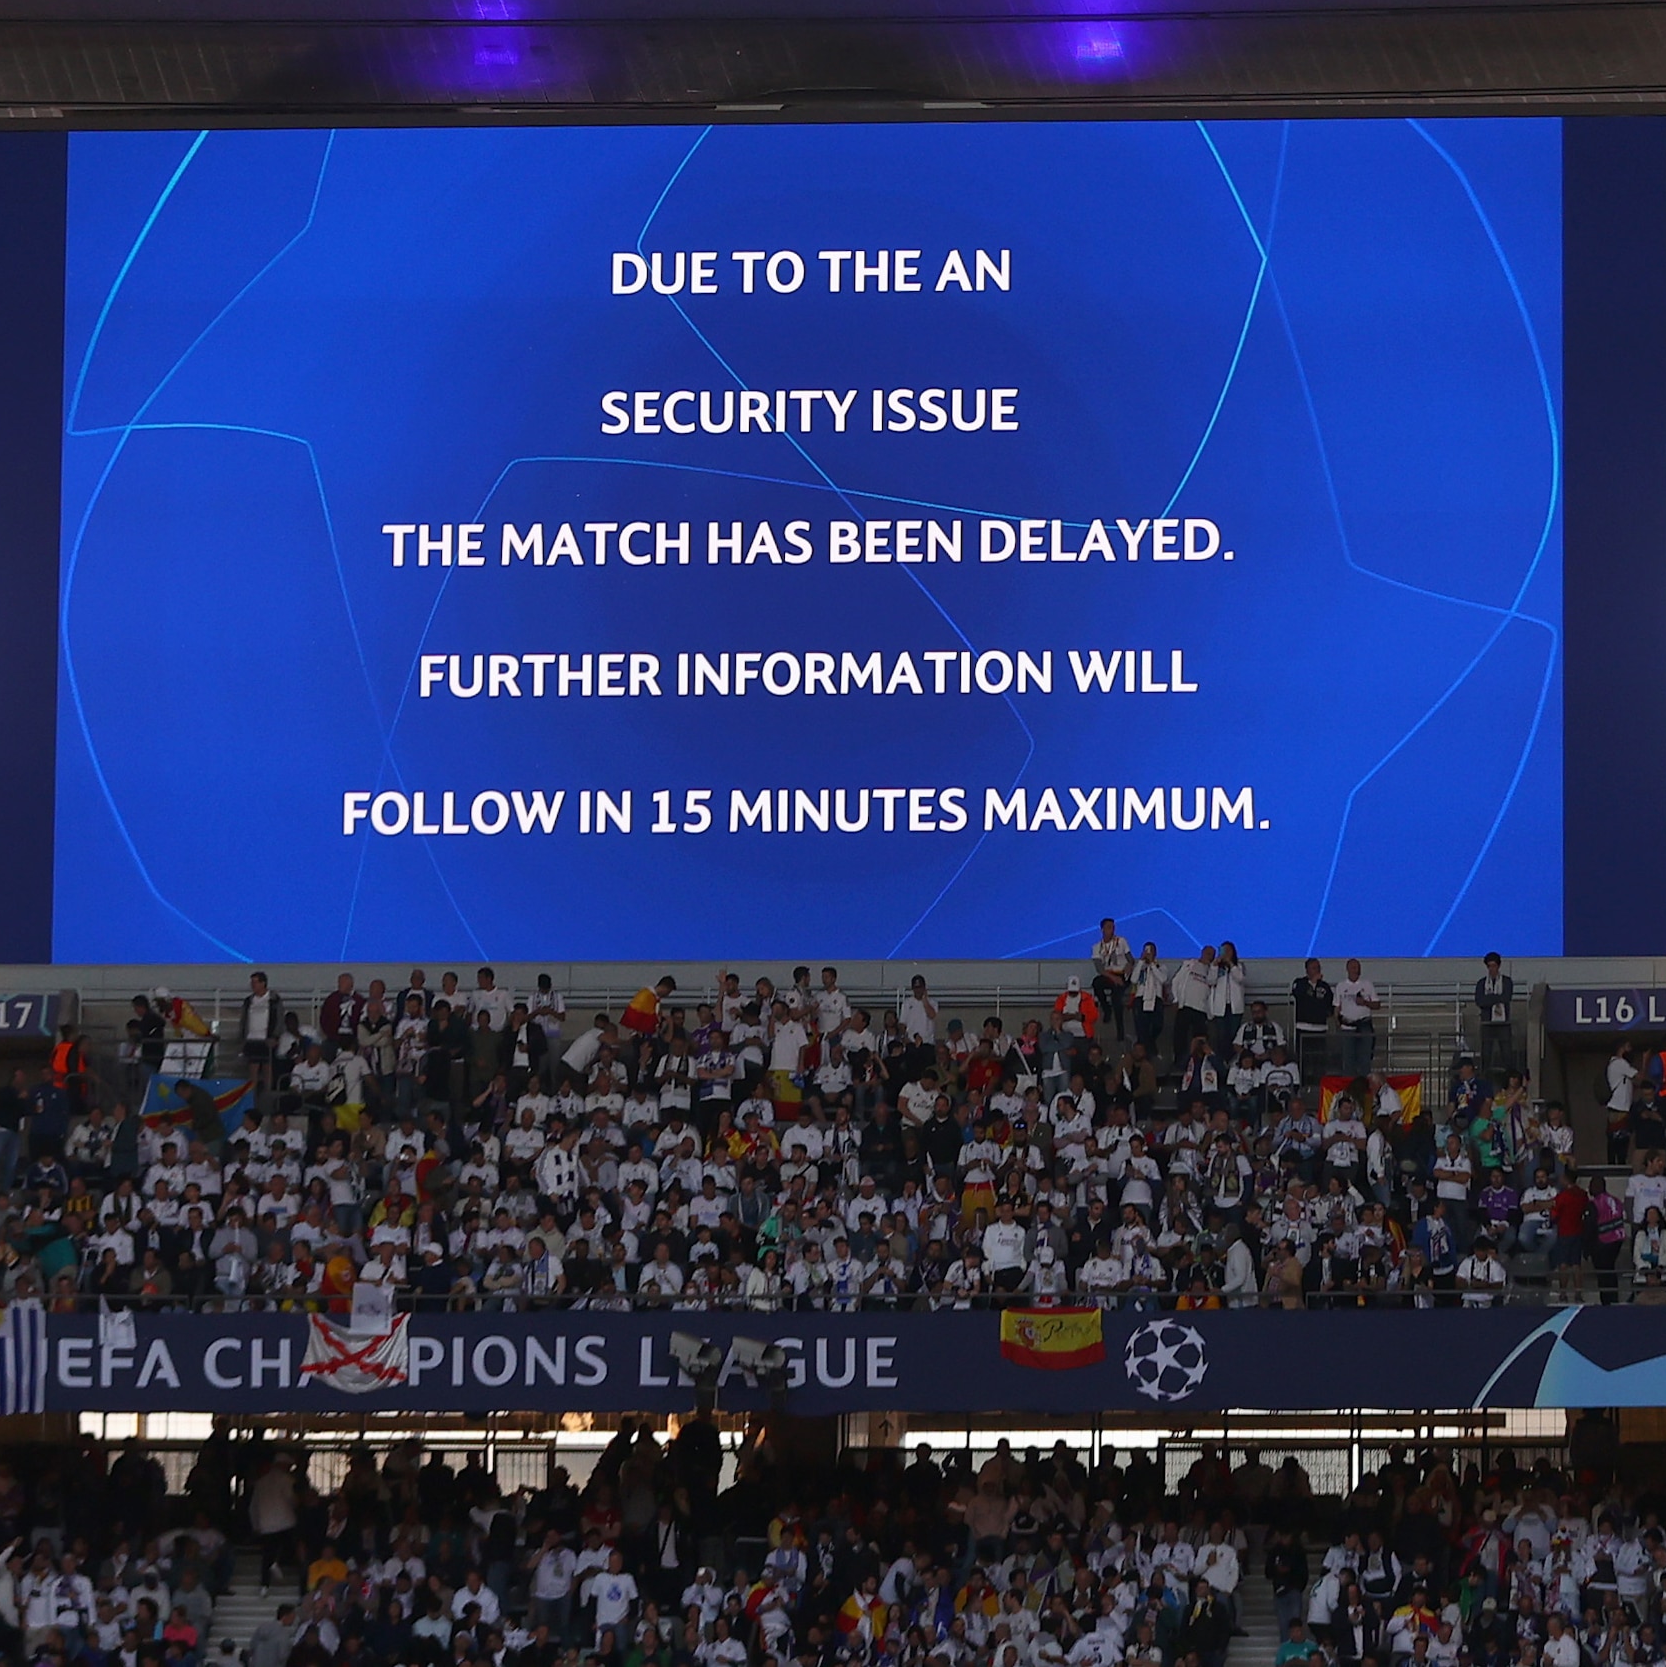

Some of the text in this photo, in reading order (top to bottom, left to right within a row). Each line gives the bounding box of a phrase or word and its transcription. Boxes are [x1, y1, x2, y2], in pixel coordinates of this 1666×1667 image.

[612, 249, 1010, 295] DUE TO THE AN
[601, 388, 1019, 434] SECURITY ISSUE
[382, 518, 1234, 567] THE MATCH HAS BEEN DELAYED.
[420, 650, 1198, 698] FURTHER INFORMATION WILL
[343, 787, 1270, 835] FOLLOW IN 15 MINUTES MAXIMUM.
[1575, 996, 1634, 1024] L16
[44, 1337, 181, 1389] EFA
[203, 1336, 610, 1389] CHPIONS
